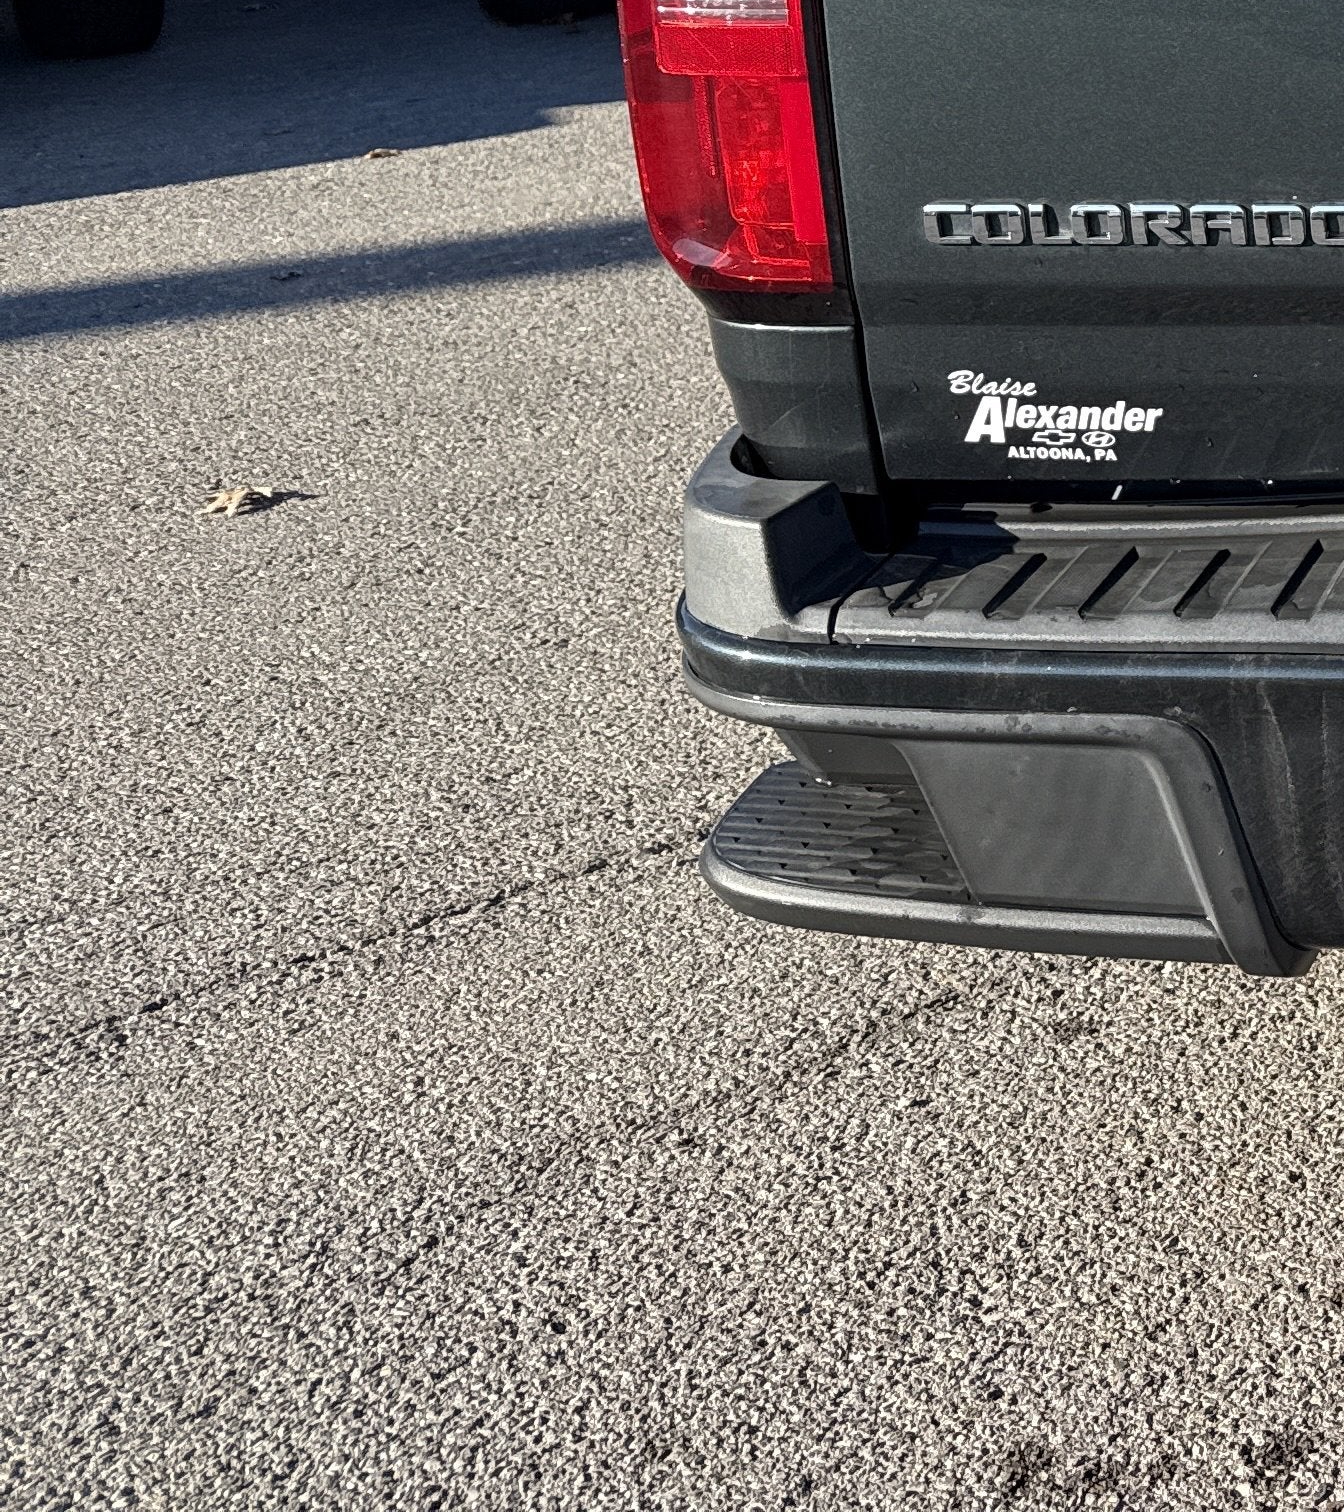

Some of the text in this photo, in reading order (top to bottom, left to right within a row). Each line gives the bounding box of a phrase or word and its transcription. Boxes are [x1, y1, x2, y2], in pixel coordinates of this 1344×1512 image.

[947, 369, 1038, 396] Blaise
[964, 395, 1163, 443] Alexander
[1007, 446, 1118, 462] ALTOONA, PA
